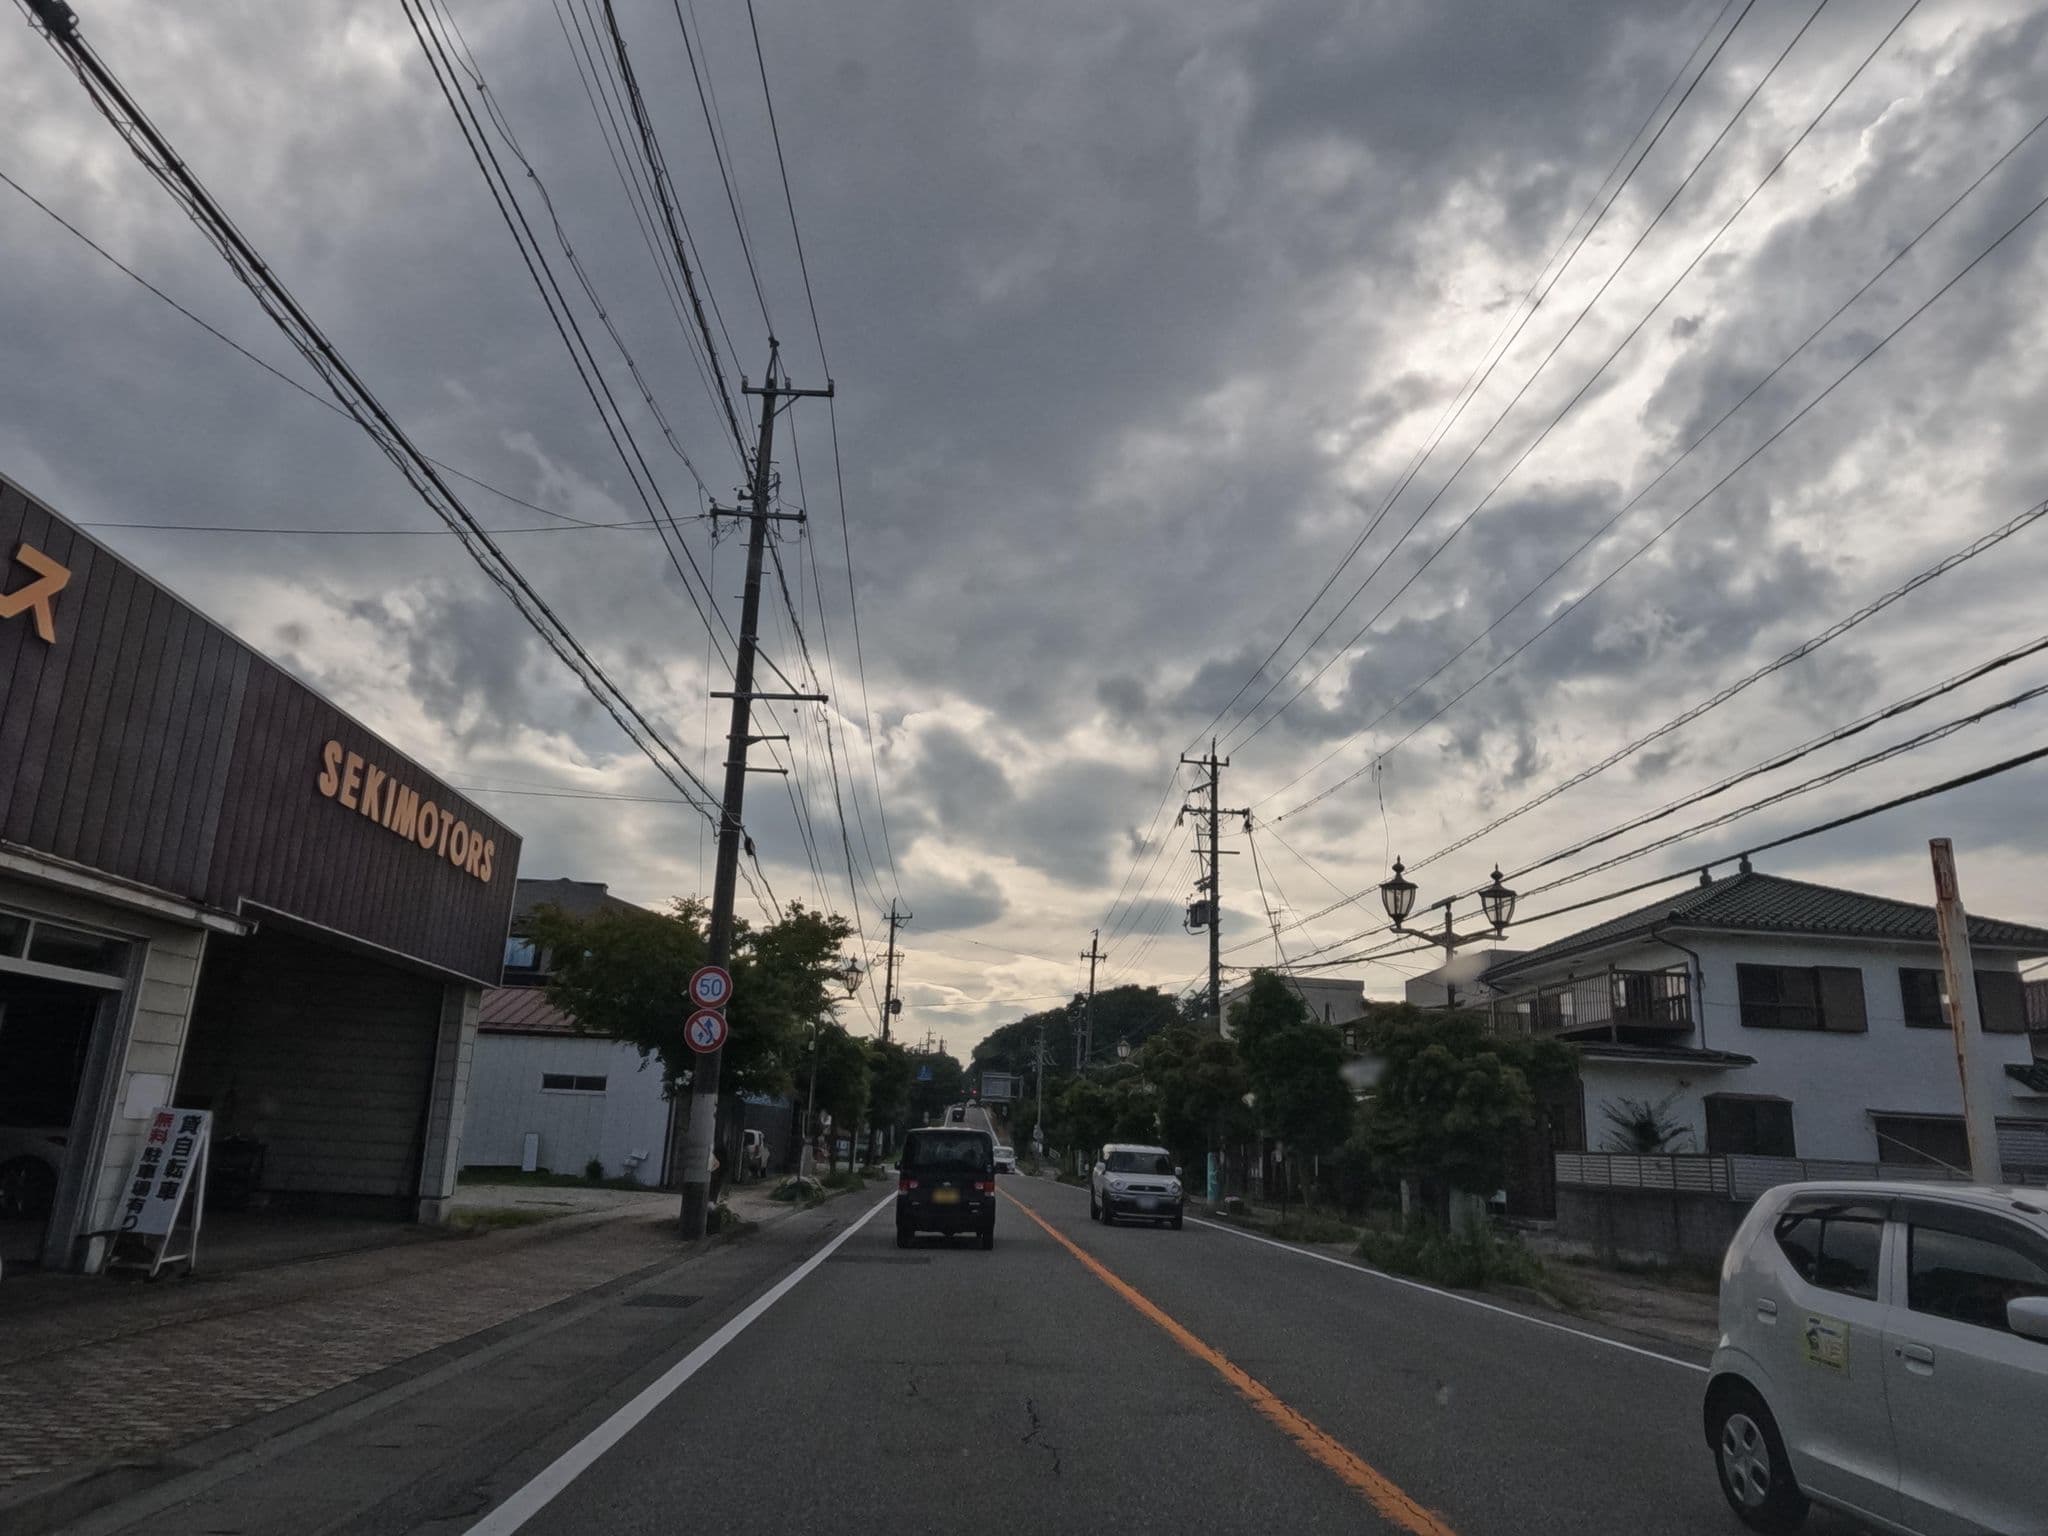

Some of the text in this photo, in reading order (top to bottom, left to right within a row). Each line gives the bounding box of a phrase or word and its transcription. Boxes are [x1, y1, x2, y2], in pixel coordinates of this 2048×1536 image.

[699, 978, 723, 997] 50
[156, 1115, 202, 1201] 貸自転車
